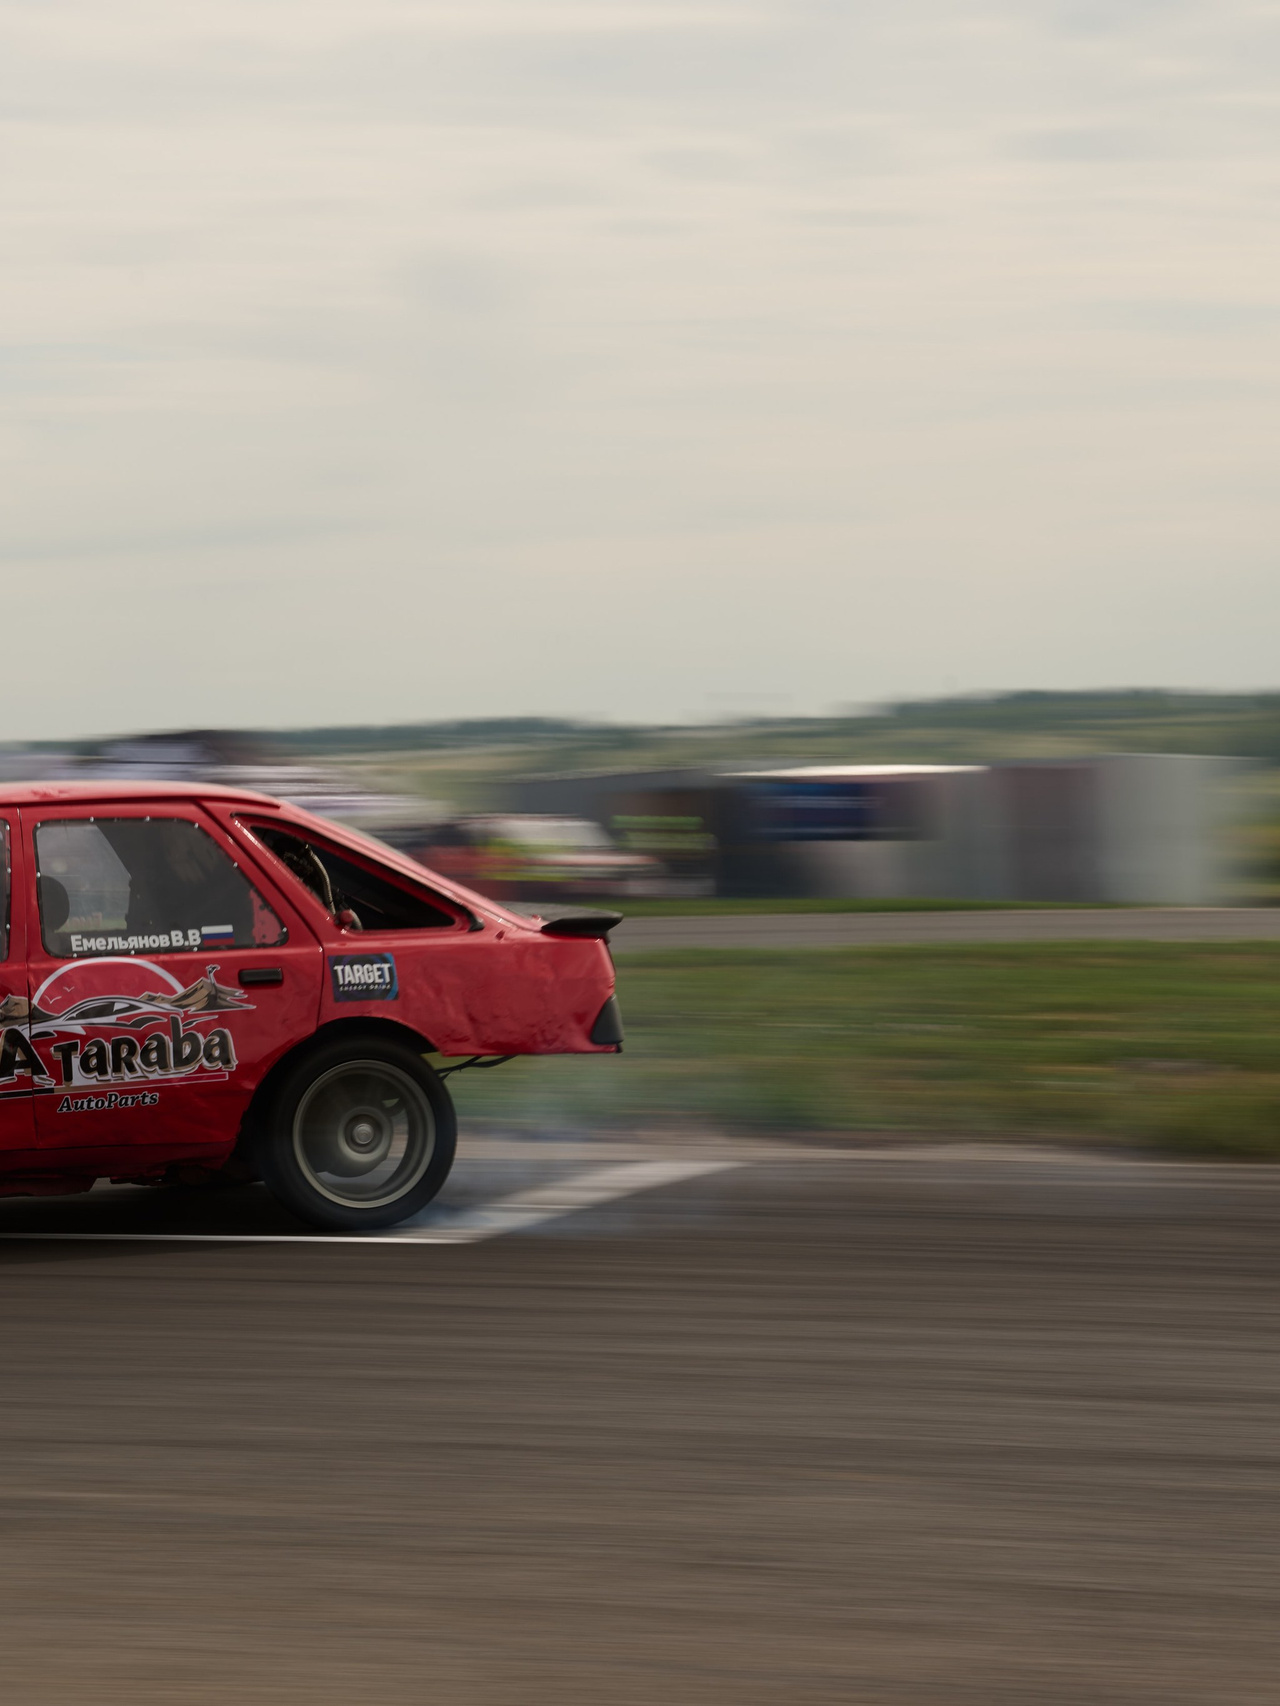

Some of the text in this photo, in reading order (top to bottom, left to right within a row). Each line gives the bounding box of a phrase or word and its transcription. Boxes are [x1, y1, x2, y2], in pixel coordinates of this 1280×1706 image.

[70, 934, 170, 952] Емельянов
[333, 963, 392, 985] TARGET
[58, 1091, 158, 1112] AutoParts
